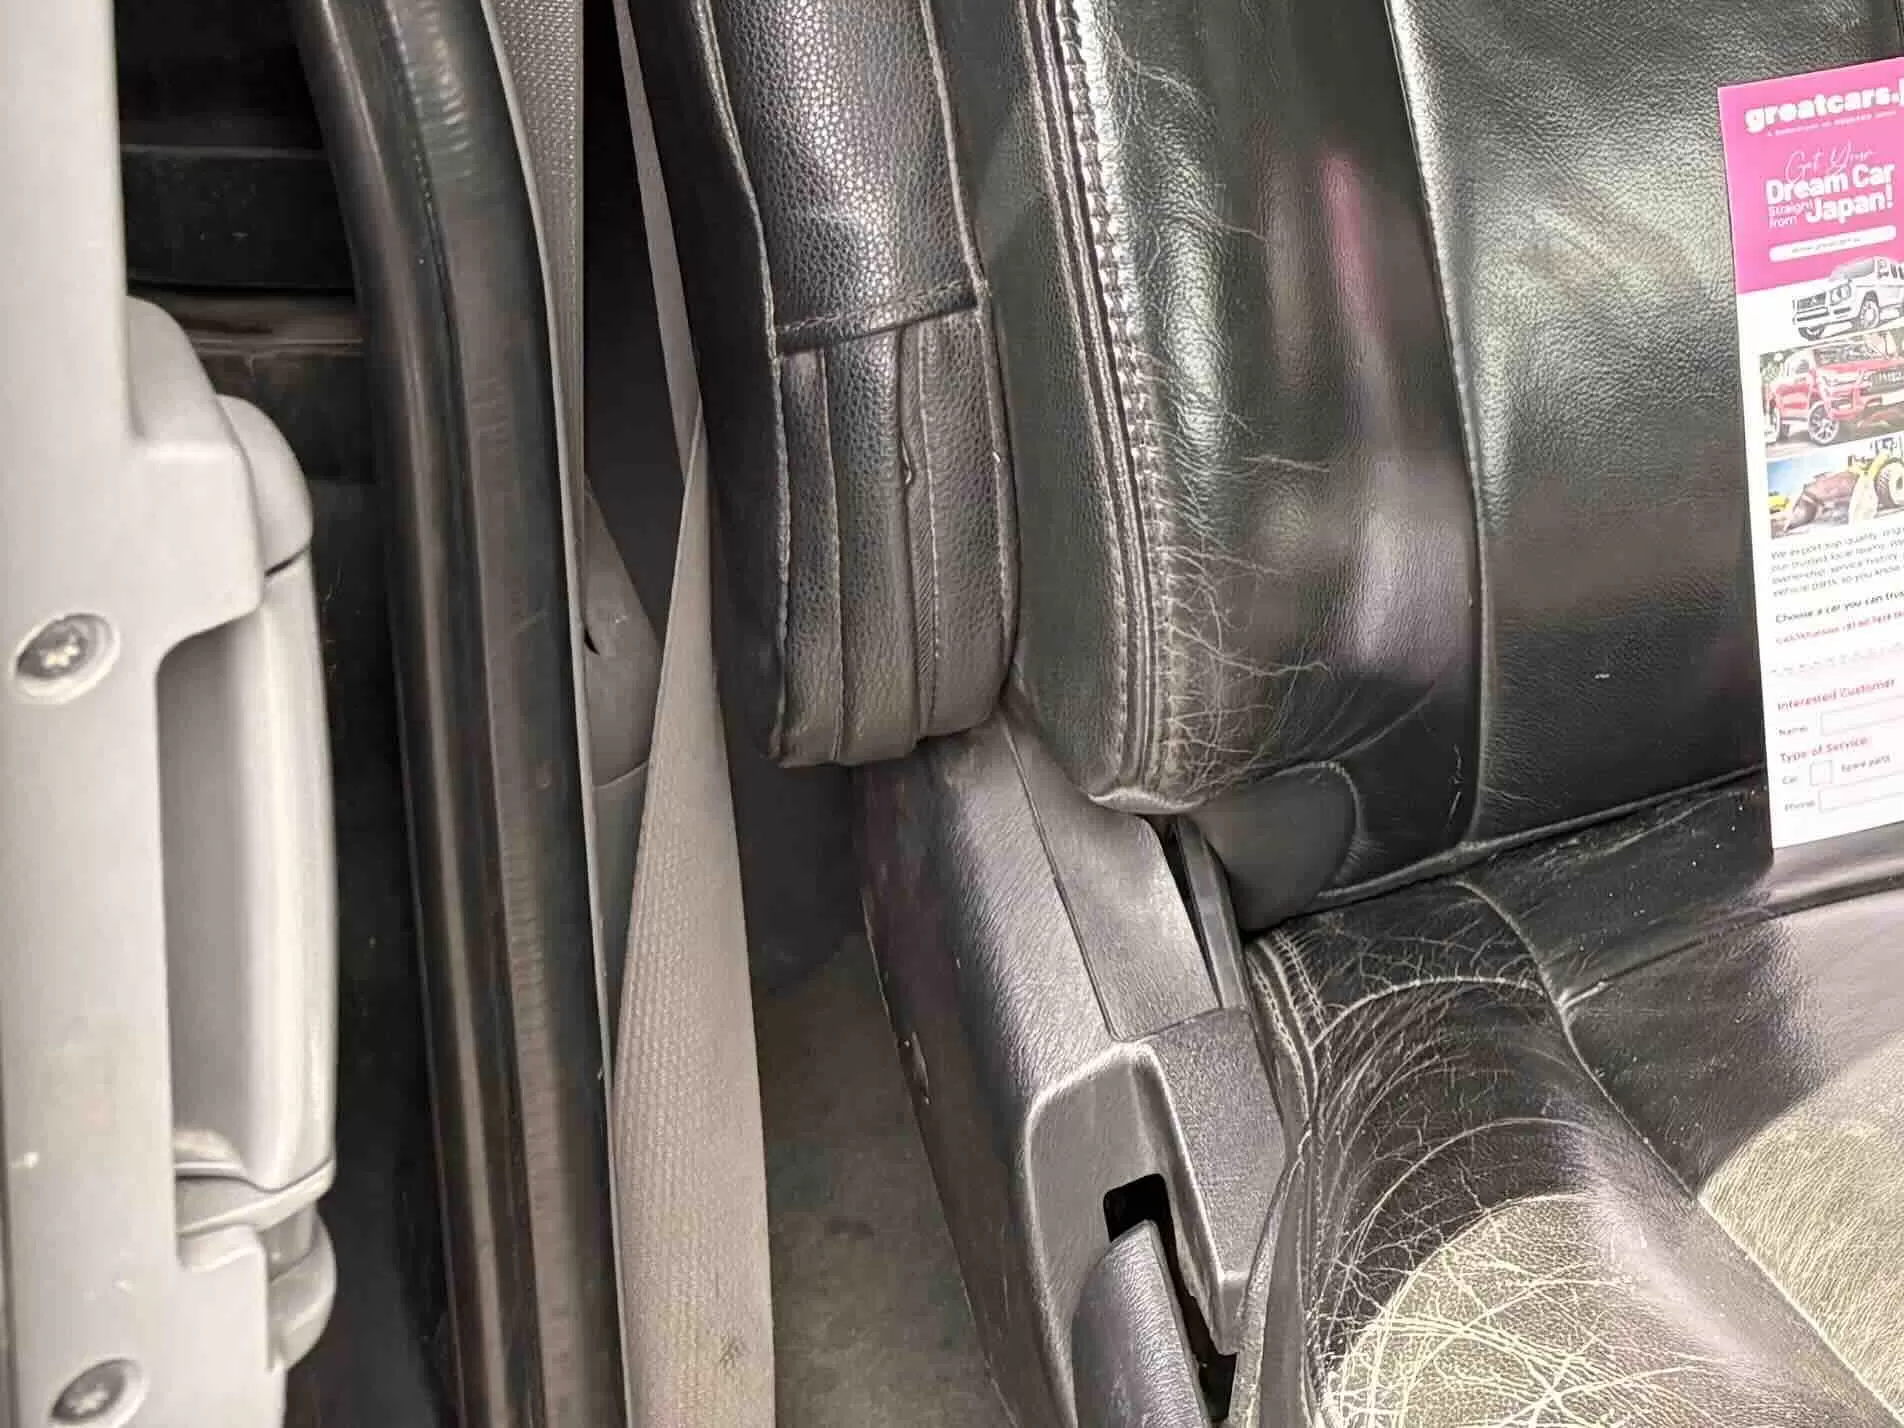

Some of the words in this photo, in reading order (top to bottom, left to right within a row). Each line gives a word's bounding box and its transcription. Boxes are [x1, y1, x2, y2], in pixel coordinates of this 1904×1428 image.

[1766, 170, 1849, 205] Dream
[1852, 163, 1896, 188] Car
[1805, 184, 1894, 225] Japan!
[1769, 215, 1798, 230] from
[1777, 689, 1837, 712] Interested
